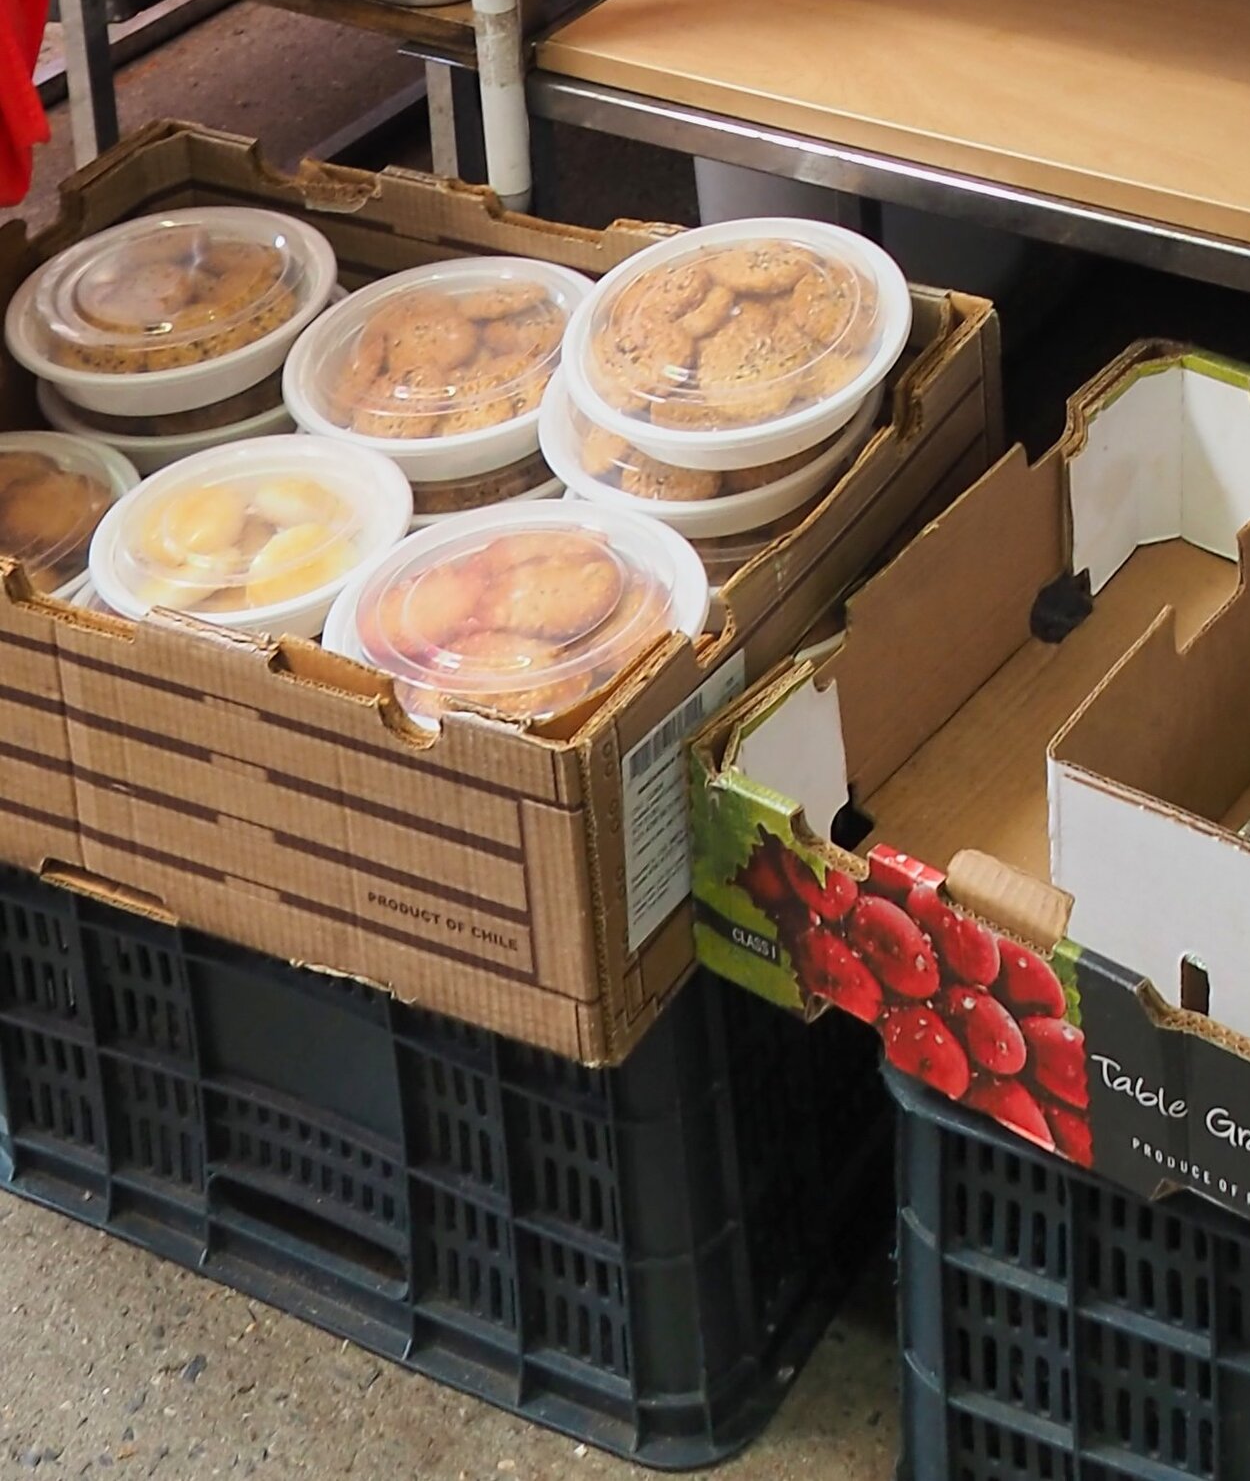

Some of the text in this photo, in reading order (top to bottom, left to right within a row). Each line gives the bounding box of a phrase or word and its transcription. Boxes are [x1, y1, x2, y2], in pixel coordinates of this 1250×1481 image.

[367, 891, 520, 952] PRODUCT OF CHILE
[731, 927, 770, 957] CLASS
[1091, 1053, 1189, 1119] Table
[1131, 1136, 1212, 1185] PRODUCE
[1218, 1177, 1238, 1198] OF
